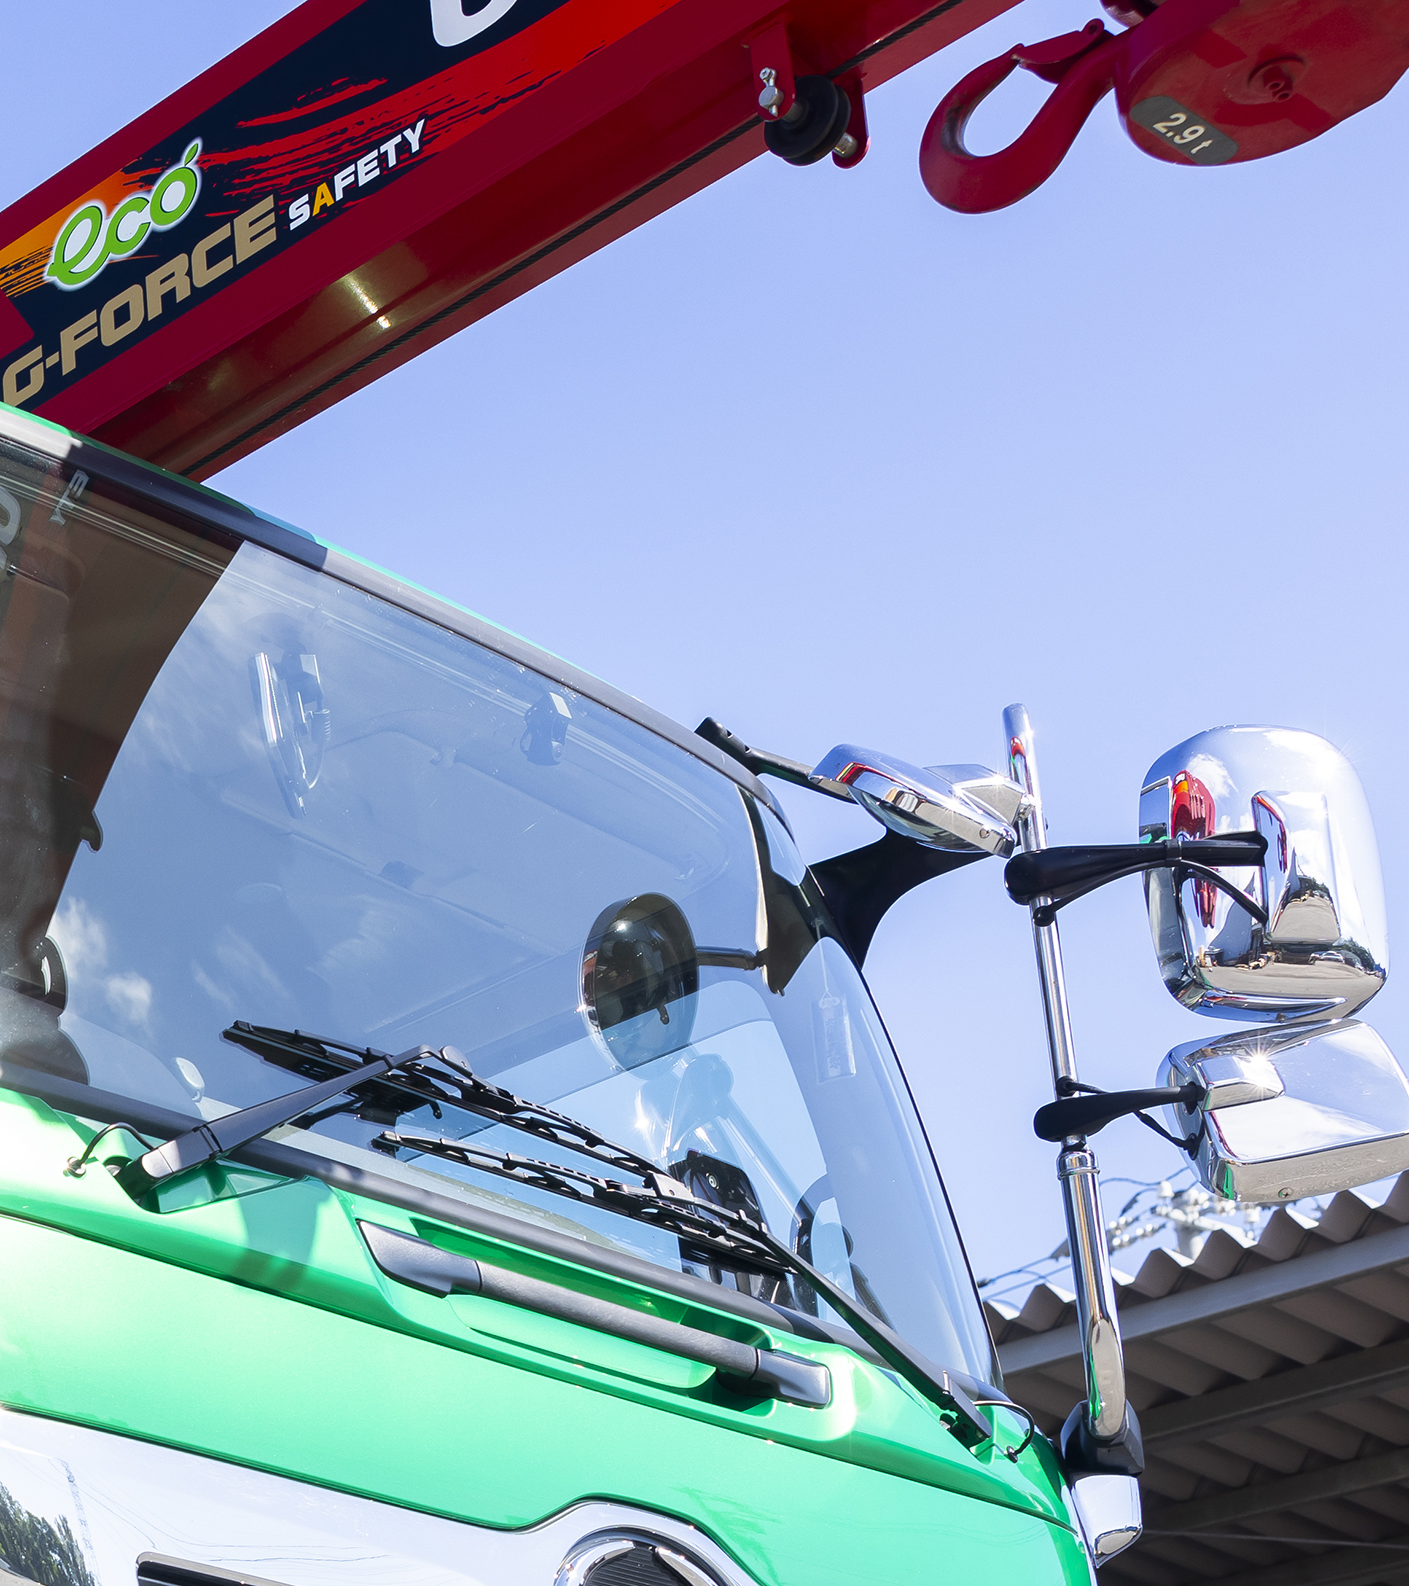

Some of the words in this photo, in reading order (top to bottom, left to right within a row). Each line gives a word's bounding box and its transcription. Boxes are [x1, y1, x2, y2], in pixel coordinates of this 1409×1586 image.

[1, 192, 278, 406] G-FORCE
[288, 118, 427, 232] SAFETY
[44, 138, 202, 287] eco
